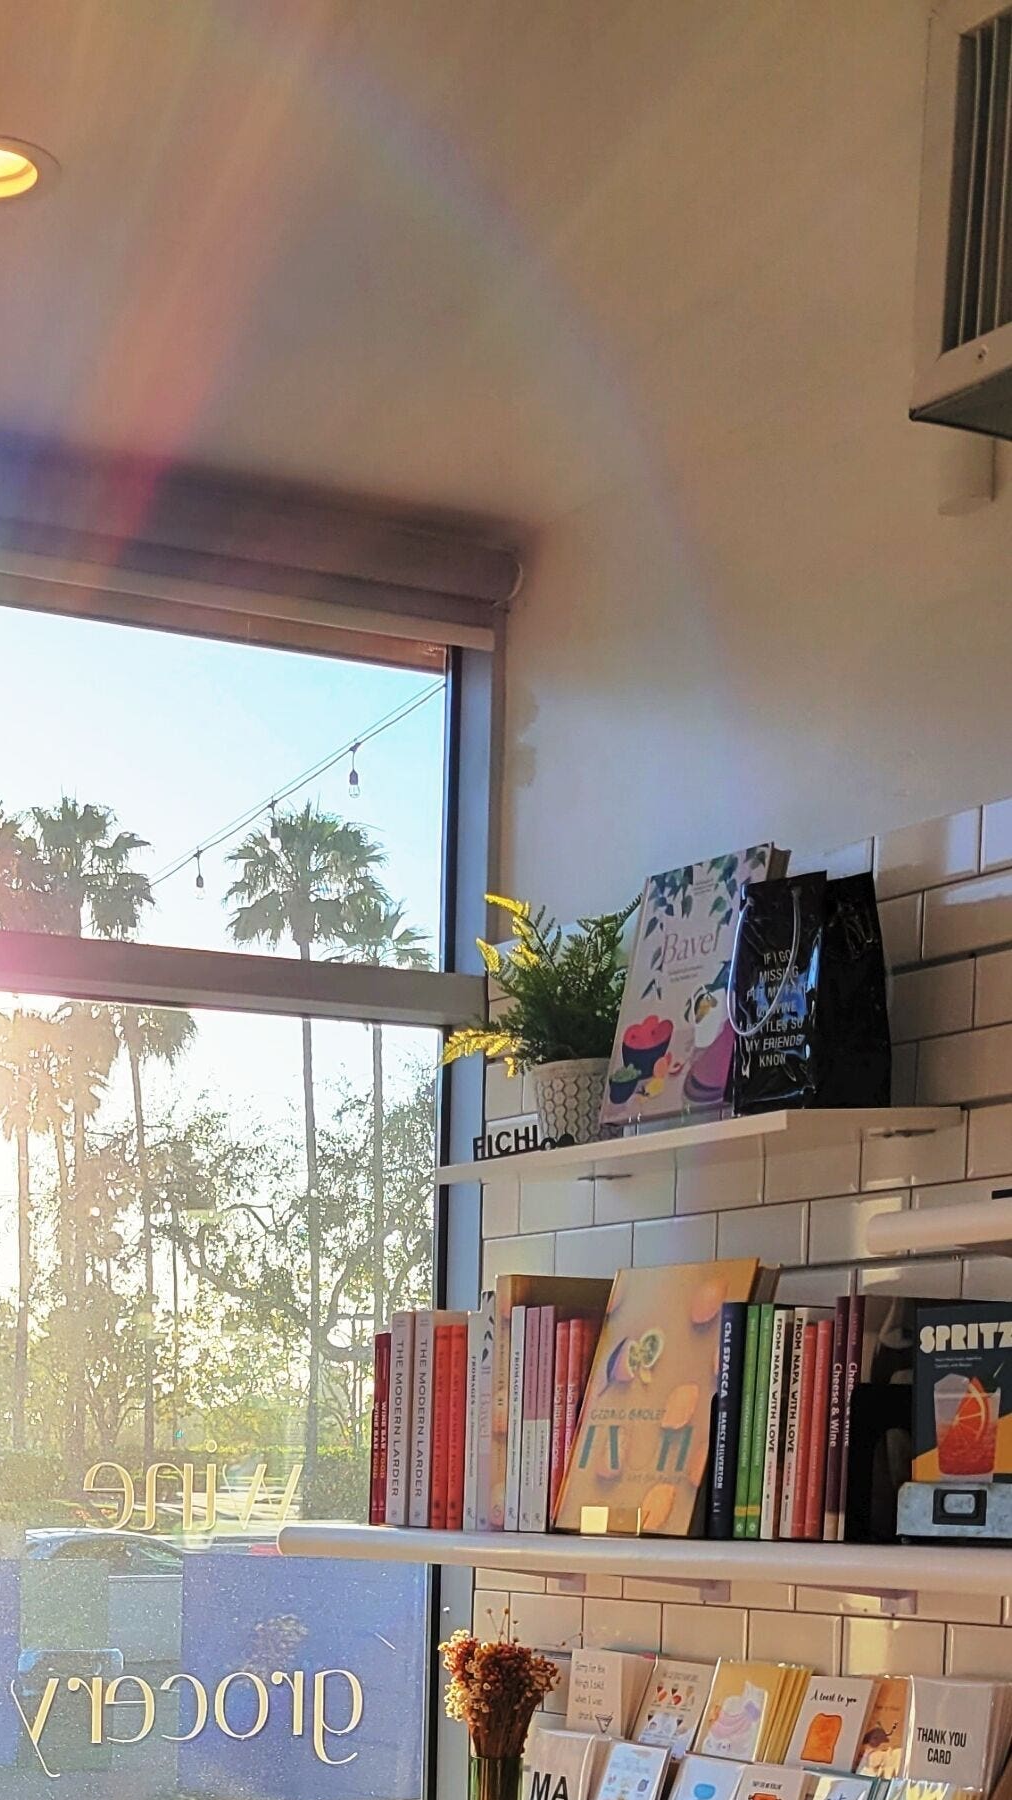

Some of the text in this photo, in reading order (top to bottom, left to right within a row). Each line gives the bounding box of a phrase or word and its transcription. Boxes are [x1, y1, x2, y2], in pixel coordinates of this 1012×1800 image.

[662, 921, 723, 964] Bavel
[763, 952, 773, 965] IF
[759, 1054, 786, 1067] KNOW
[794, 1317, 803, 1349] FROM
[720, 1346, 731, 1399] SPACCA
[792, 1354, 801, 1385] NAPA
[831, 1362, 842, 1405] Cheese
[768, 1318, 783, 1453] FROM NAPA WITH LOVE
[391, 1340, 404, 1497] THE MODERN LARDER
[415, 1339, 428, 1496] THE MODERN LARDER
[789, 1390, 798, 1419] WITH
[787, 1424, 796, 1453] LOVE
[829, 1418, 839, 1447] Wine
[717, 1411, 728, 1489] NANCY SILVERTON
[845, 1697, 857, 1707] you
[917, 1727, 967, 1748] THANK YOU
[927, 1748, 952, 1765] CARD
